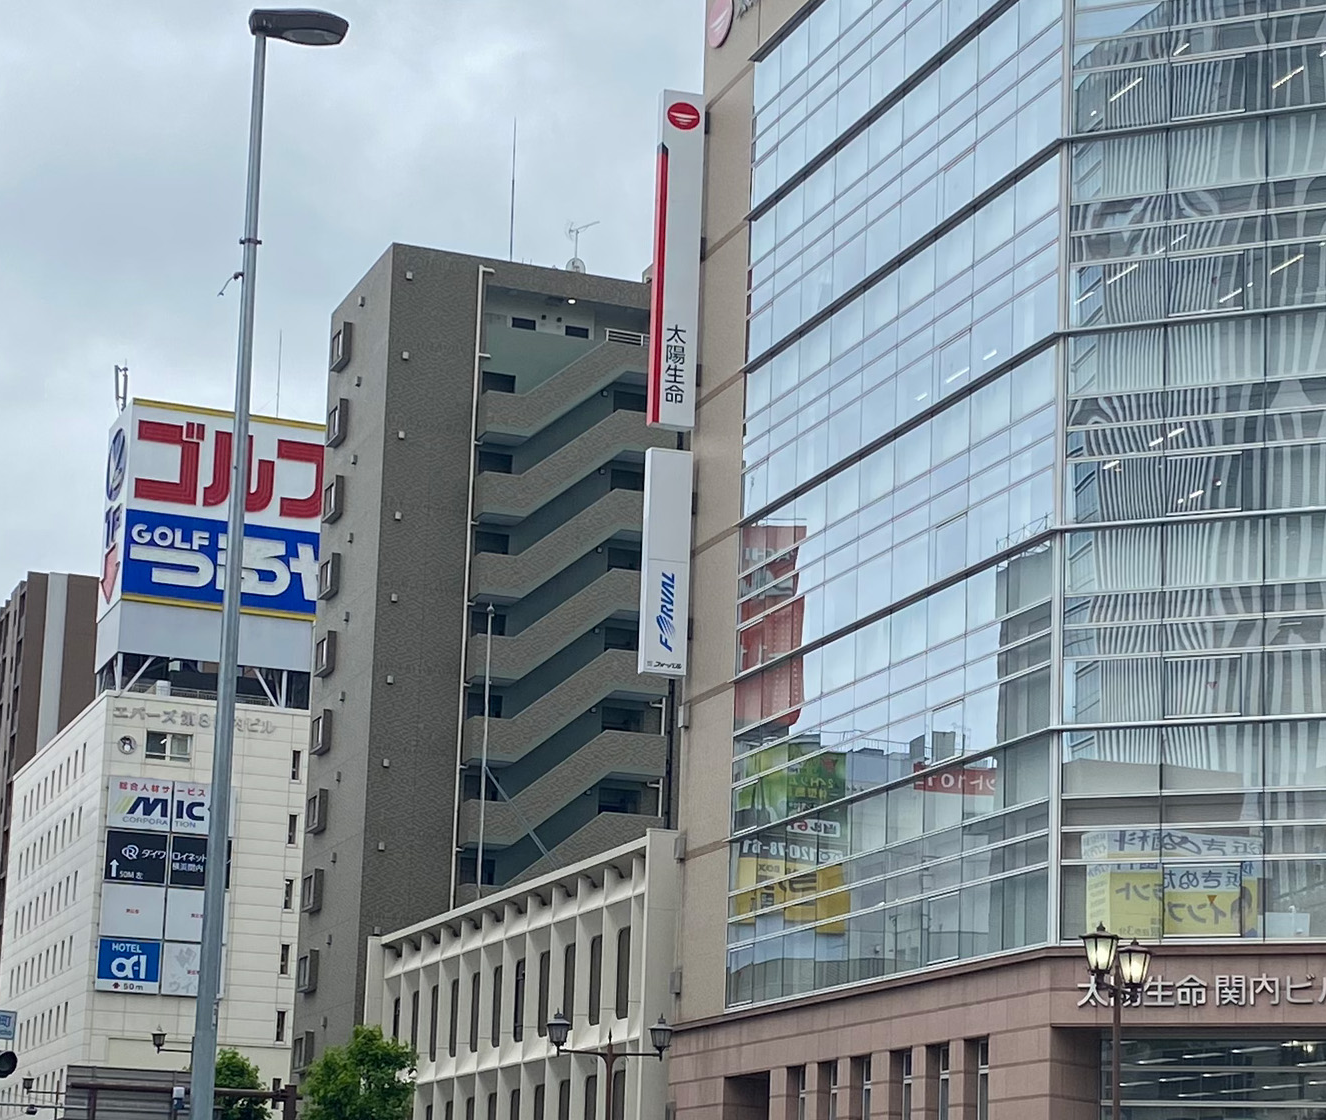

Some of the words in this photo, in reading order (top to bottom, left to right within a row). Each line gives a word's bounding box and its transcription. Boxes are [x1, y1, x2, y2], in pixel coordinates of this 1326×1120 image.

[665, 324, 687, 405] 太陽生命
[131, 523, 210, 551] GOLF
[122, 815, 196, 829] CORPORATION
[126, 796, 205, 822] MIC
[111, 942, 143, 953] HOTEL
